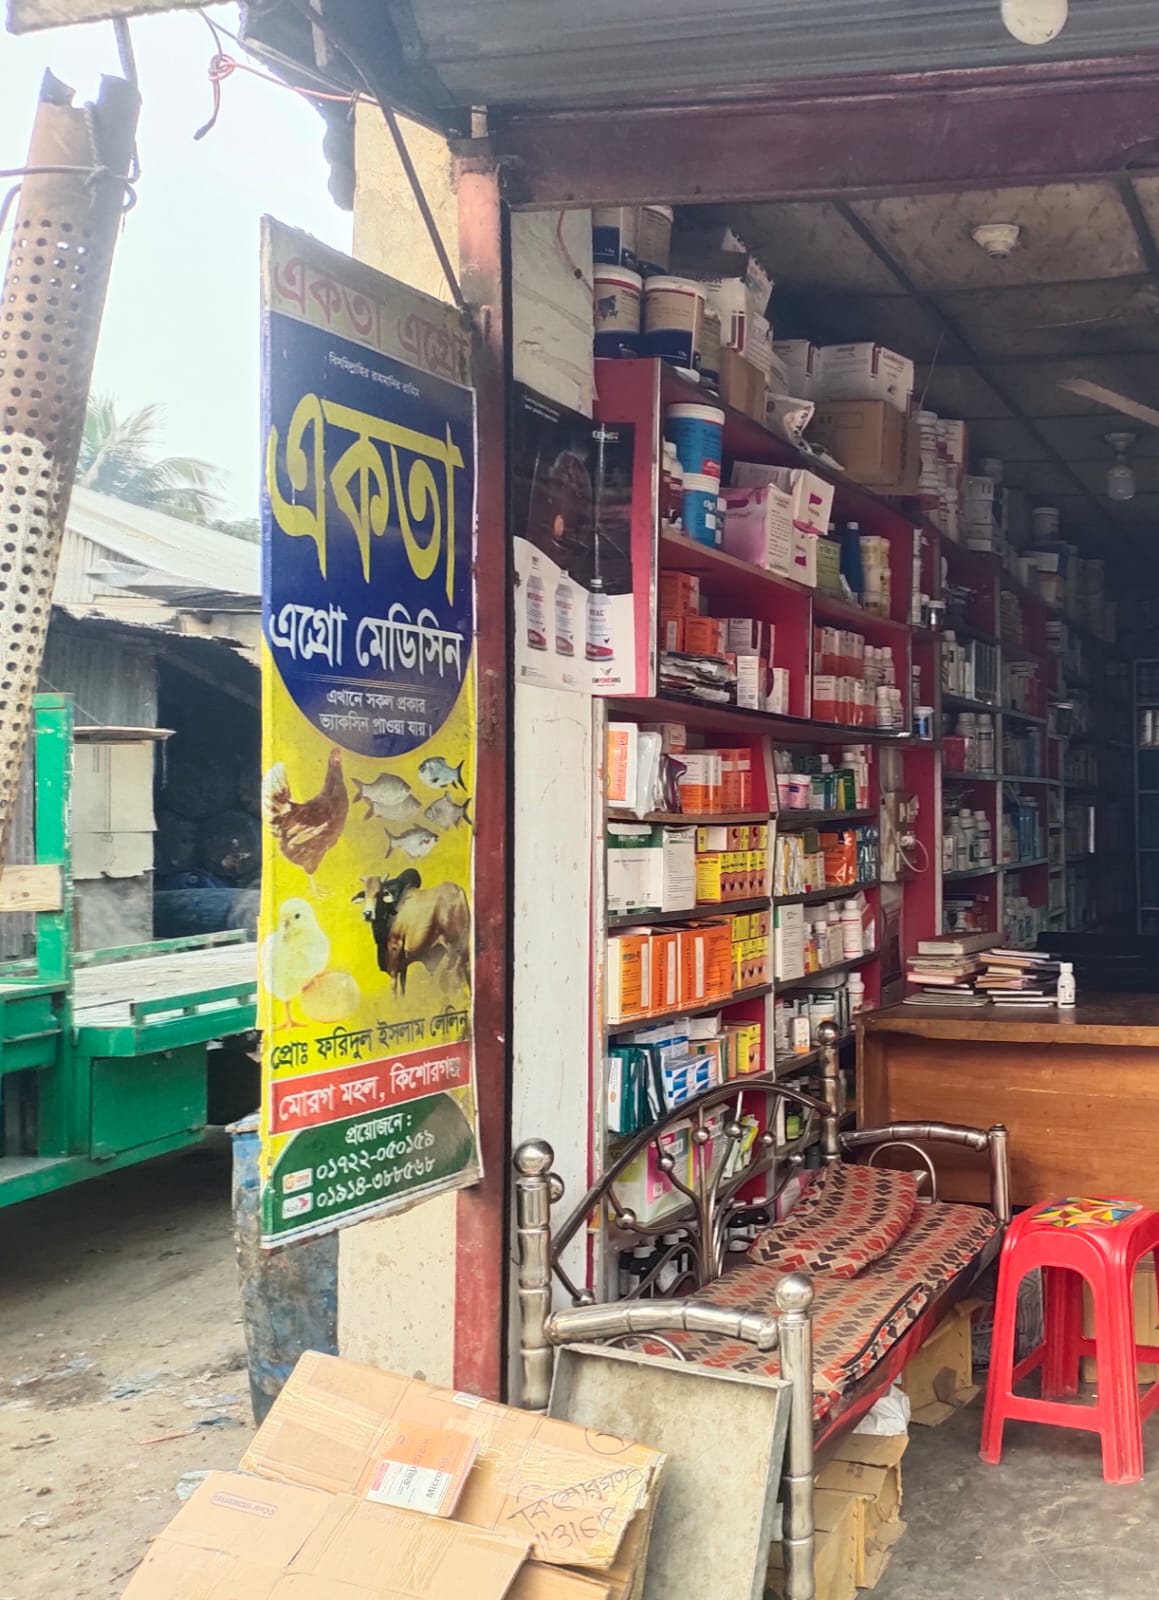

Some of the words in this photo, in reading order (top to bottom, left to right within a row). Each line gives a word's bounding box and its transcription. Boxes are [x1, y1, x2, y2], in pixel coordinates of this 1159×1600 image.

[273, 257, 380, 349] একতা
[266, 393, 464, 607] একতা
[269, 602, 348, 668] এগ্রো
[355, 602, 464, 682] মেডিসিন
[326, 689, 364, 708] এখানে
[365, 692, 395, 711] সকল
[397, 696, 427, 714] প্রকার
[372, 718, 405, 735] পাওয়া
[315, 1026, 374, 1059] ফরিদুল
[376, 1018, 425, 1048] ইসলাম
[430, 1004, 469, 1040] লেলিন
[278, 1084, 334, 1121] মোরগ
